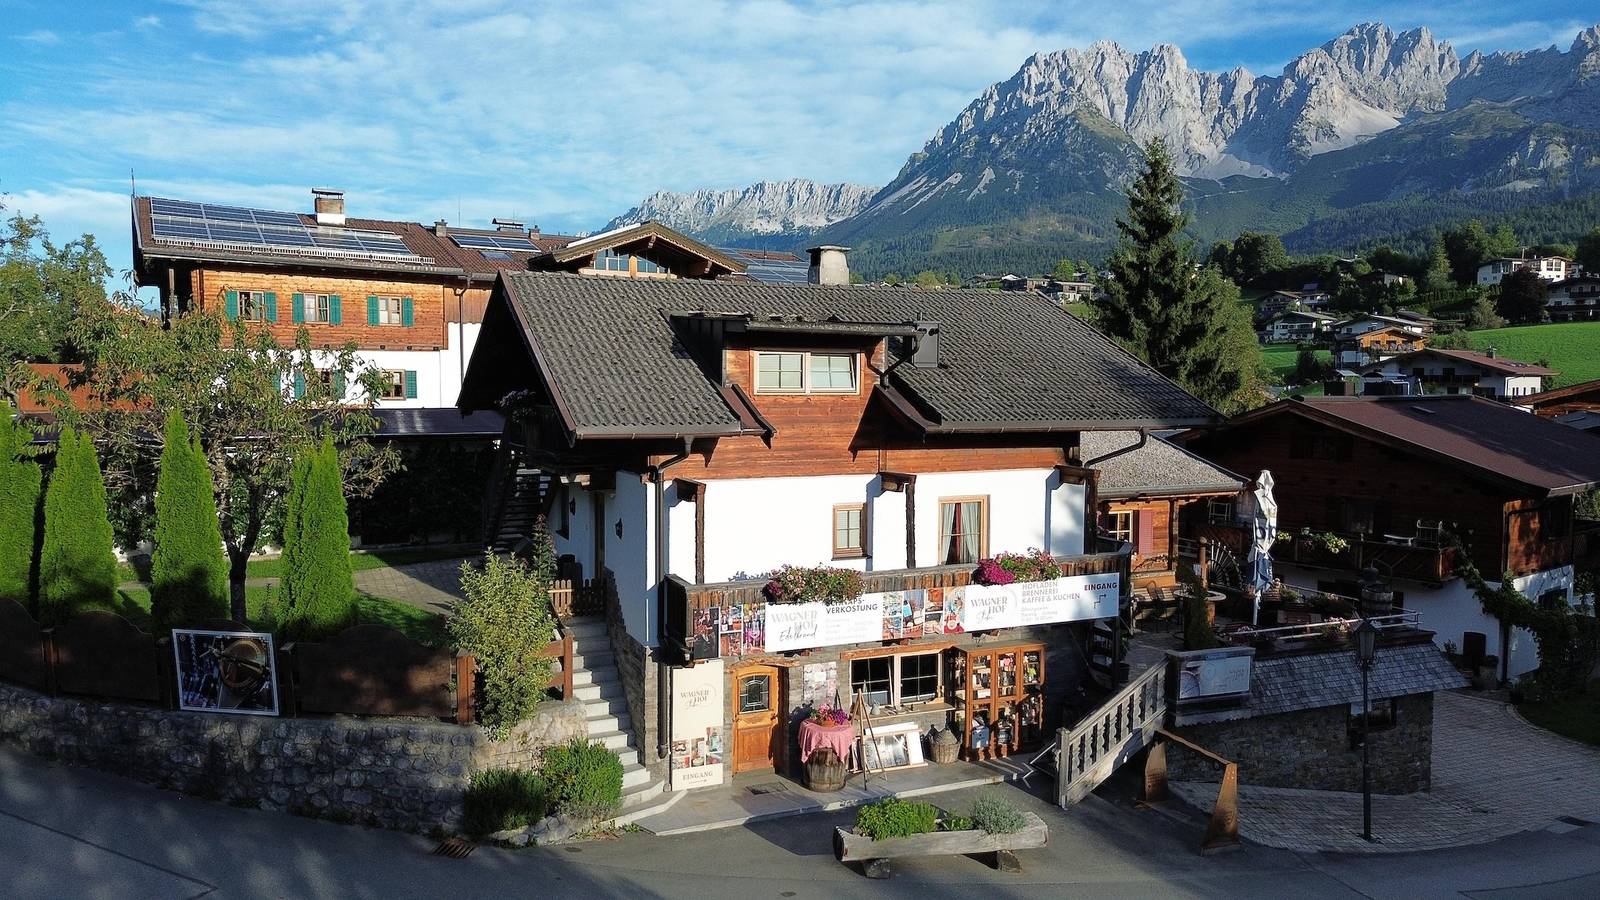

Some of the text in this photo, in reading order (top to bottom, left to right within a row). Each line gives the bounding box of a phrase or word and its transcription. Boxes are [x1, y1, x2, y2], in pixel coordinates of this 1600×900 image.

[1022, 581, 1058, 591] HOFLADEN
[1084, 582, 1118, 591] EINGANG
[1022, 588, 1058, 597] BRENNEREI
[1022, 595, 1045, 604] KAFFEE
[1053, 592, 1081, 602] KUCHEN
[970, 596, 1008, 607] WAGNER
[825, 603, 878, 614] VERKOSTUNG
[988, 604, 1006, 615] HOF
[770, 610, 818, 624] WAGNER
[793, 619, 815, 633] HOF
[680, 690, 709, 699] WAGNER
[683, 770, 713, 781] EINGANG
